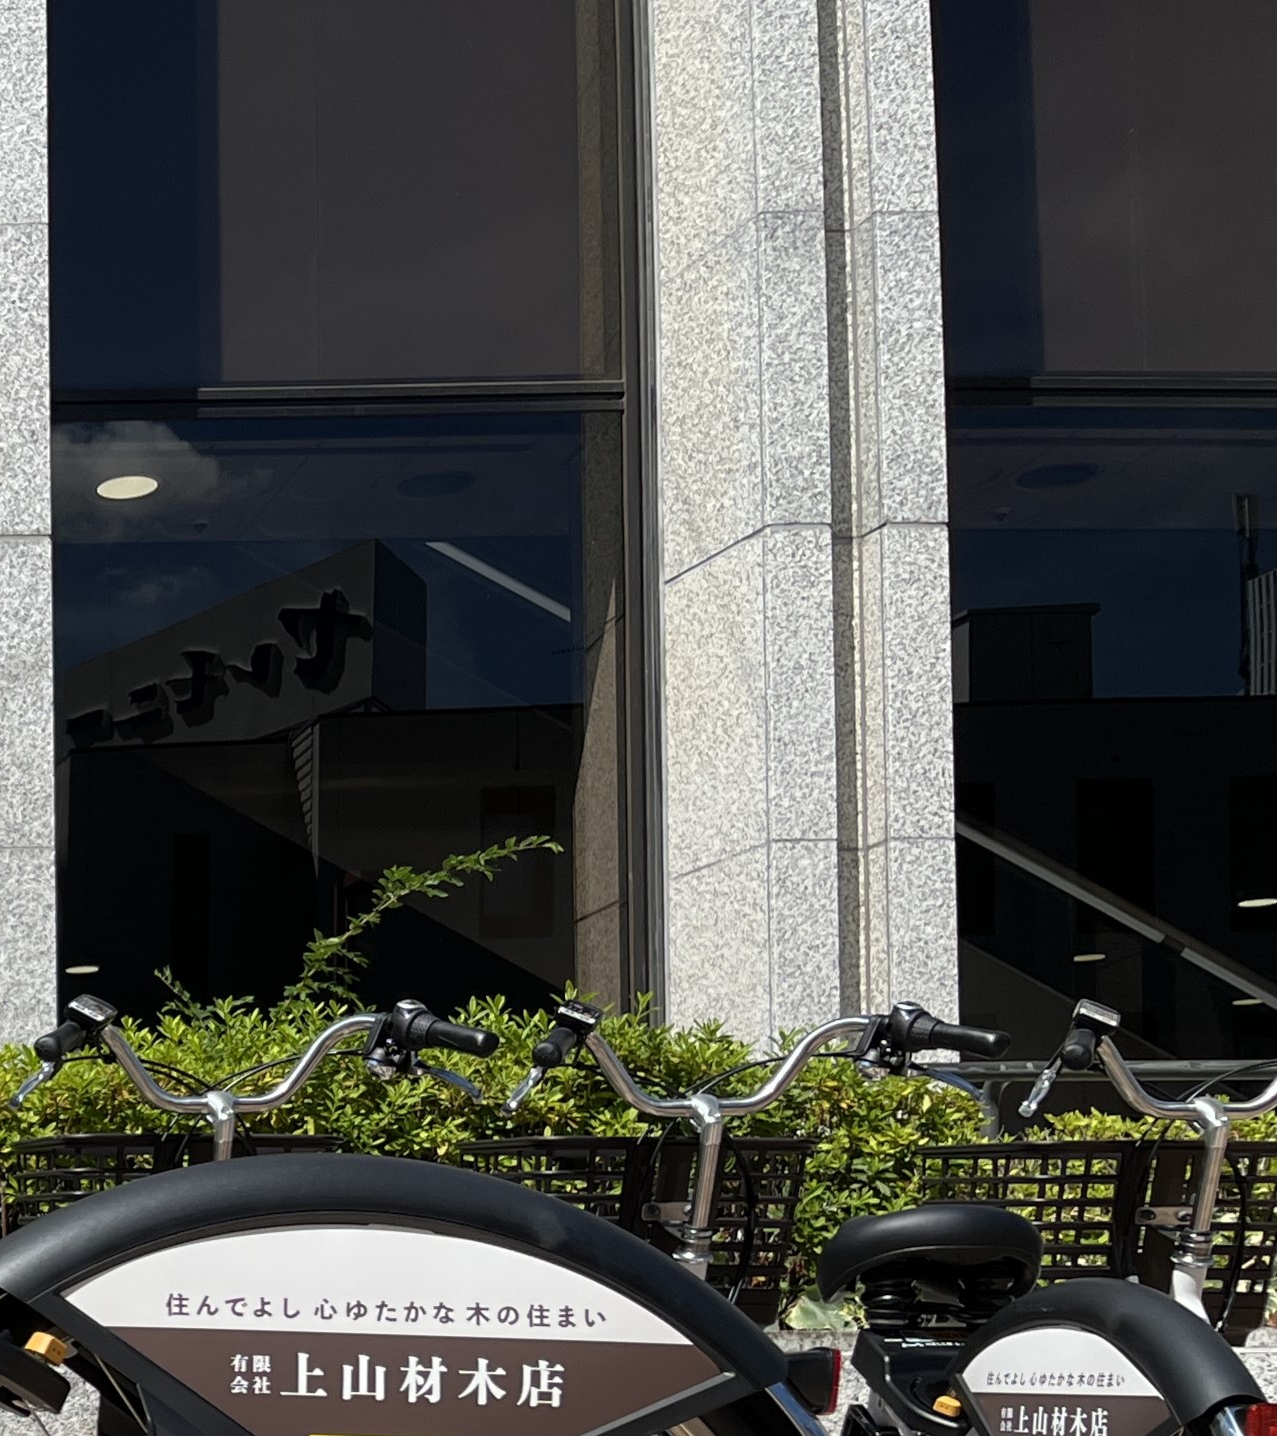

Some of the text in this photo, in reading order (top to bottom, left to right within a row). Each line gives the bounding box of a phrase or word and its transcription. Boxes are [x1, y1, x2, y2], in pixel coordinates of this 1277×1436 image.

[165, 1293, 607, 1328] 住んでよし 心ゆたかな 木の住まい
[279, 1352, 565, 1408] 上山材木店
[986, 1371, 1126, 1387] 住んでよし 心ゆたかな 木の住まい
